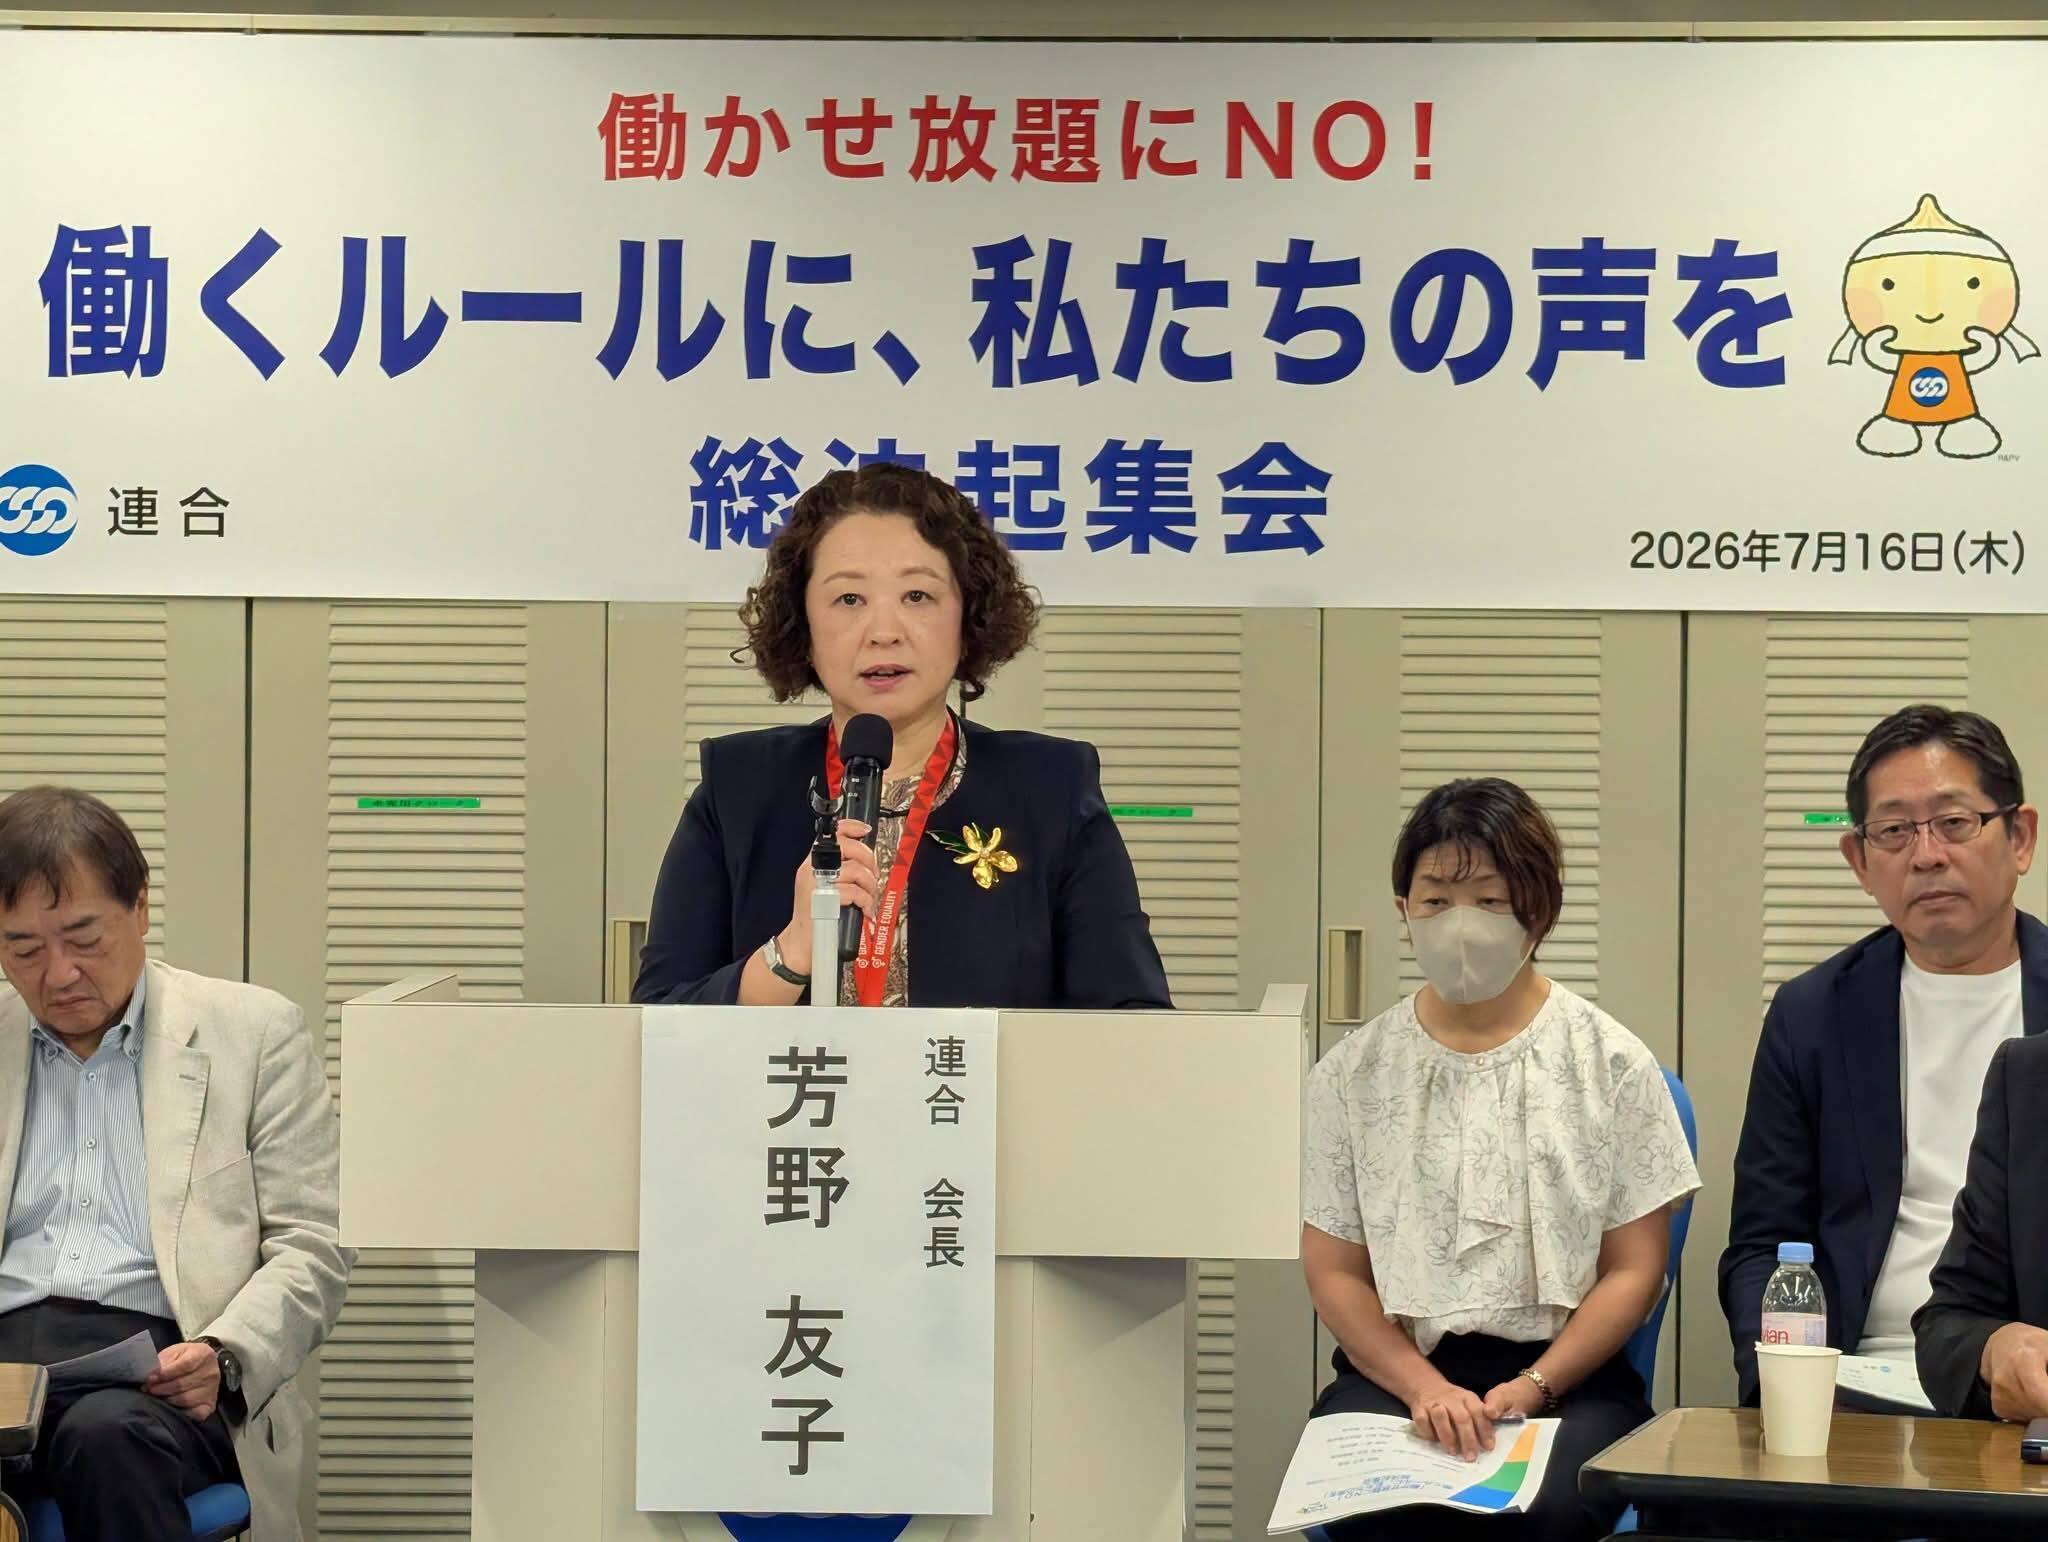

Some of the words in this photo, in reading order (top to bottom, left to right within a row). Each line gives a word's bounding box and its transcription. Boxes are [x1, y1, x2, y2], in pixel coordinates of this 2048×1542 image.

[598, 93, 1434, 183] 働かせ放題にNO!
[38, 223, 1794, 389] 働くルールに、私たちの声を
[107, 486, 231, 538] 連合
[874, 925, 889, 955] GENDER
[880, 890, 897, 924] EQUALITY
[924, 1035, 967, 1125] 連合
[763, 1046, 850, 1229] 芳野
[923, 1177, 965, 1269] 会長
[761, 1294, 845, 1476] 友子
